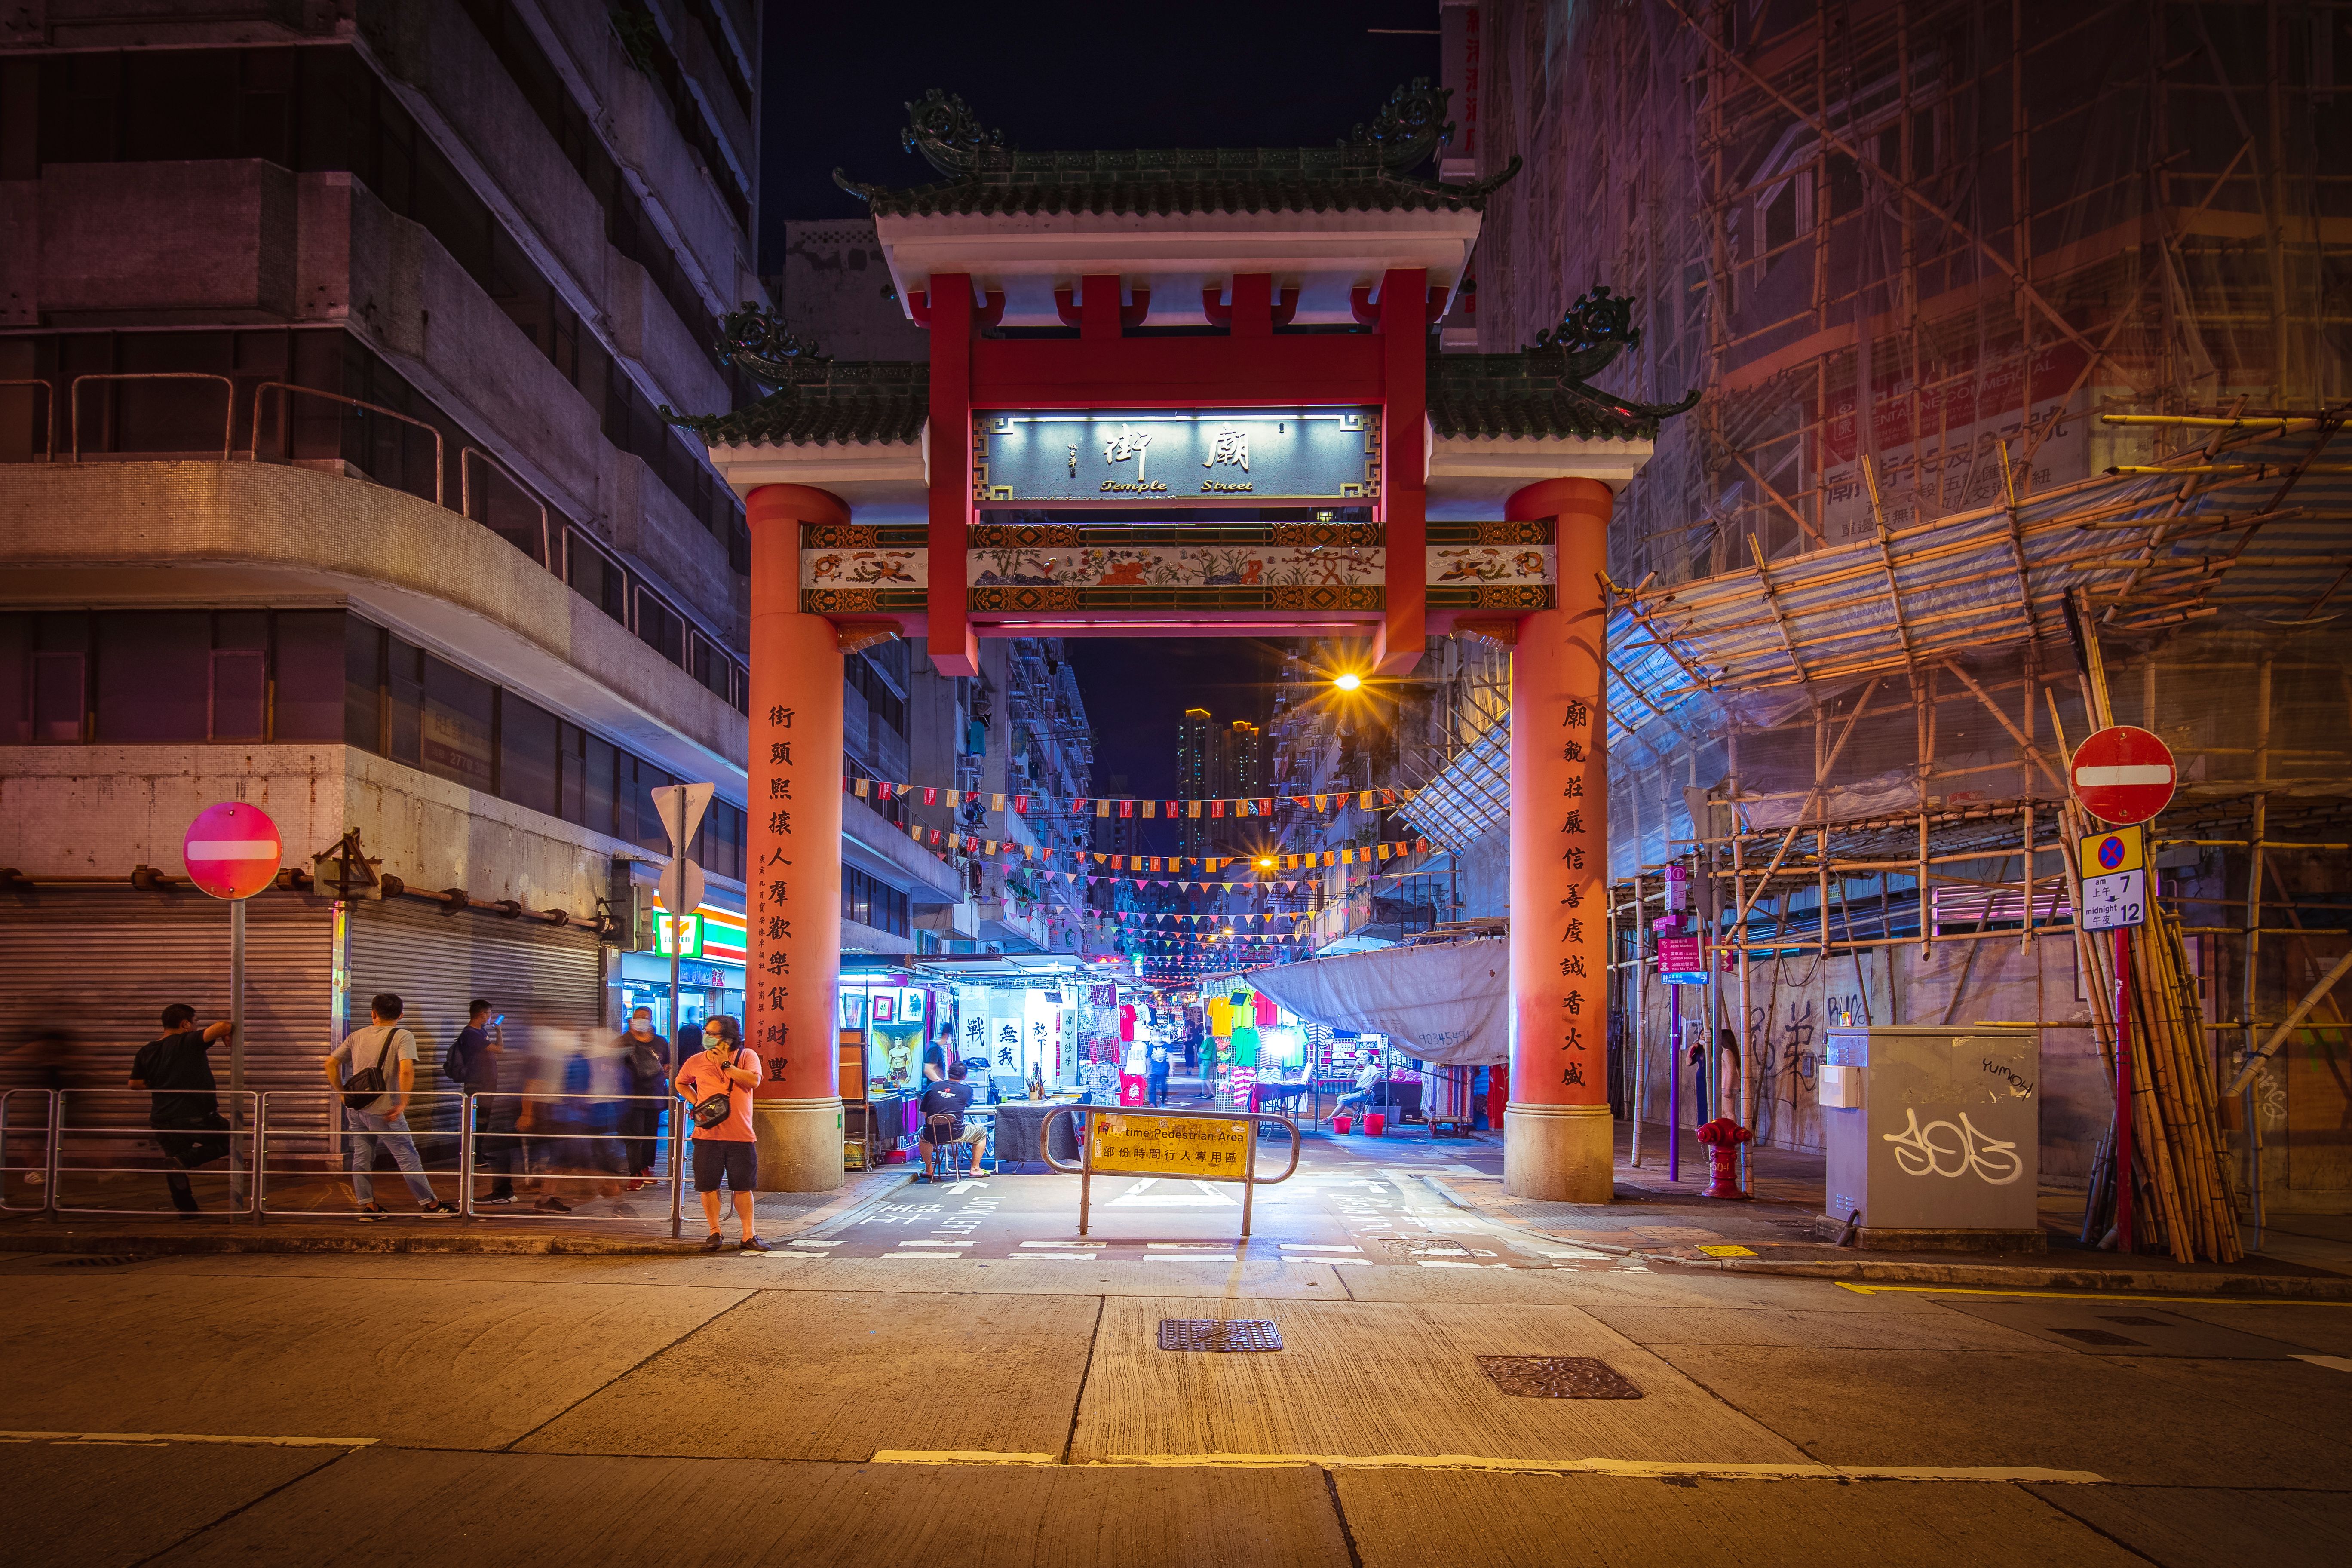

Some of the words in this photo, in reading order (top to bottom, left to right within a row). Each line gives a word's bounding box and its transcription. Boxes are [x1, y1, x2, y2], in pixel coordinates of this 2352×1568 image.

[1100, 480, 1167, 494] Temple
[1201, 479, 1253, 491] Street
[1672, 883, 1678, 893] Ma
[2093, 887, 2110, 898] 上午
[2120, 875, 2131, 893] 7
[2086, 904, 2117, 915] midnight
[2121, 903, 2140, 922] 12
[2093, 915, 2110, 925] 午夜
[966, 1016, 985, 1047] 戰
[1154, 1129, 1214, 1141] Pedestrian
[1218, 1131, 1244, 1142] Area
[1103, 1146, 1236, 1163] 部份時間行人專用區
[955, 1196, 1006, 1215] LOOK
[930, 1216, 987, 1235] LEFT
